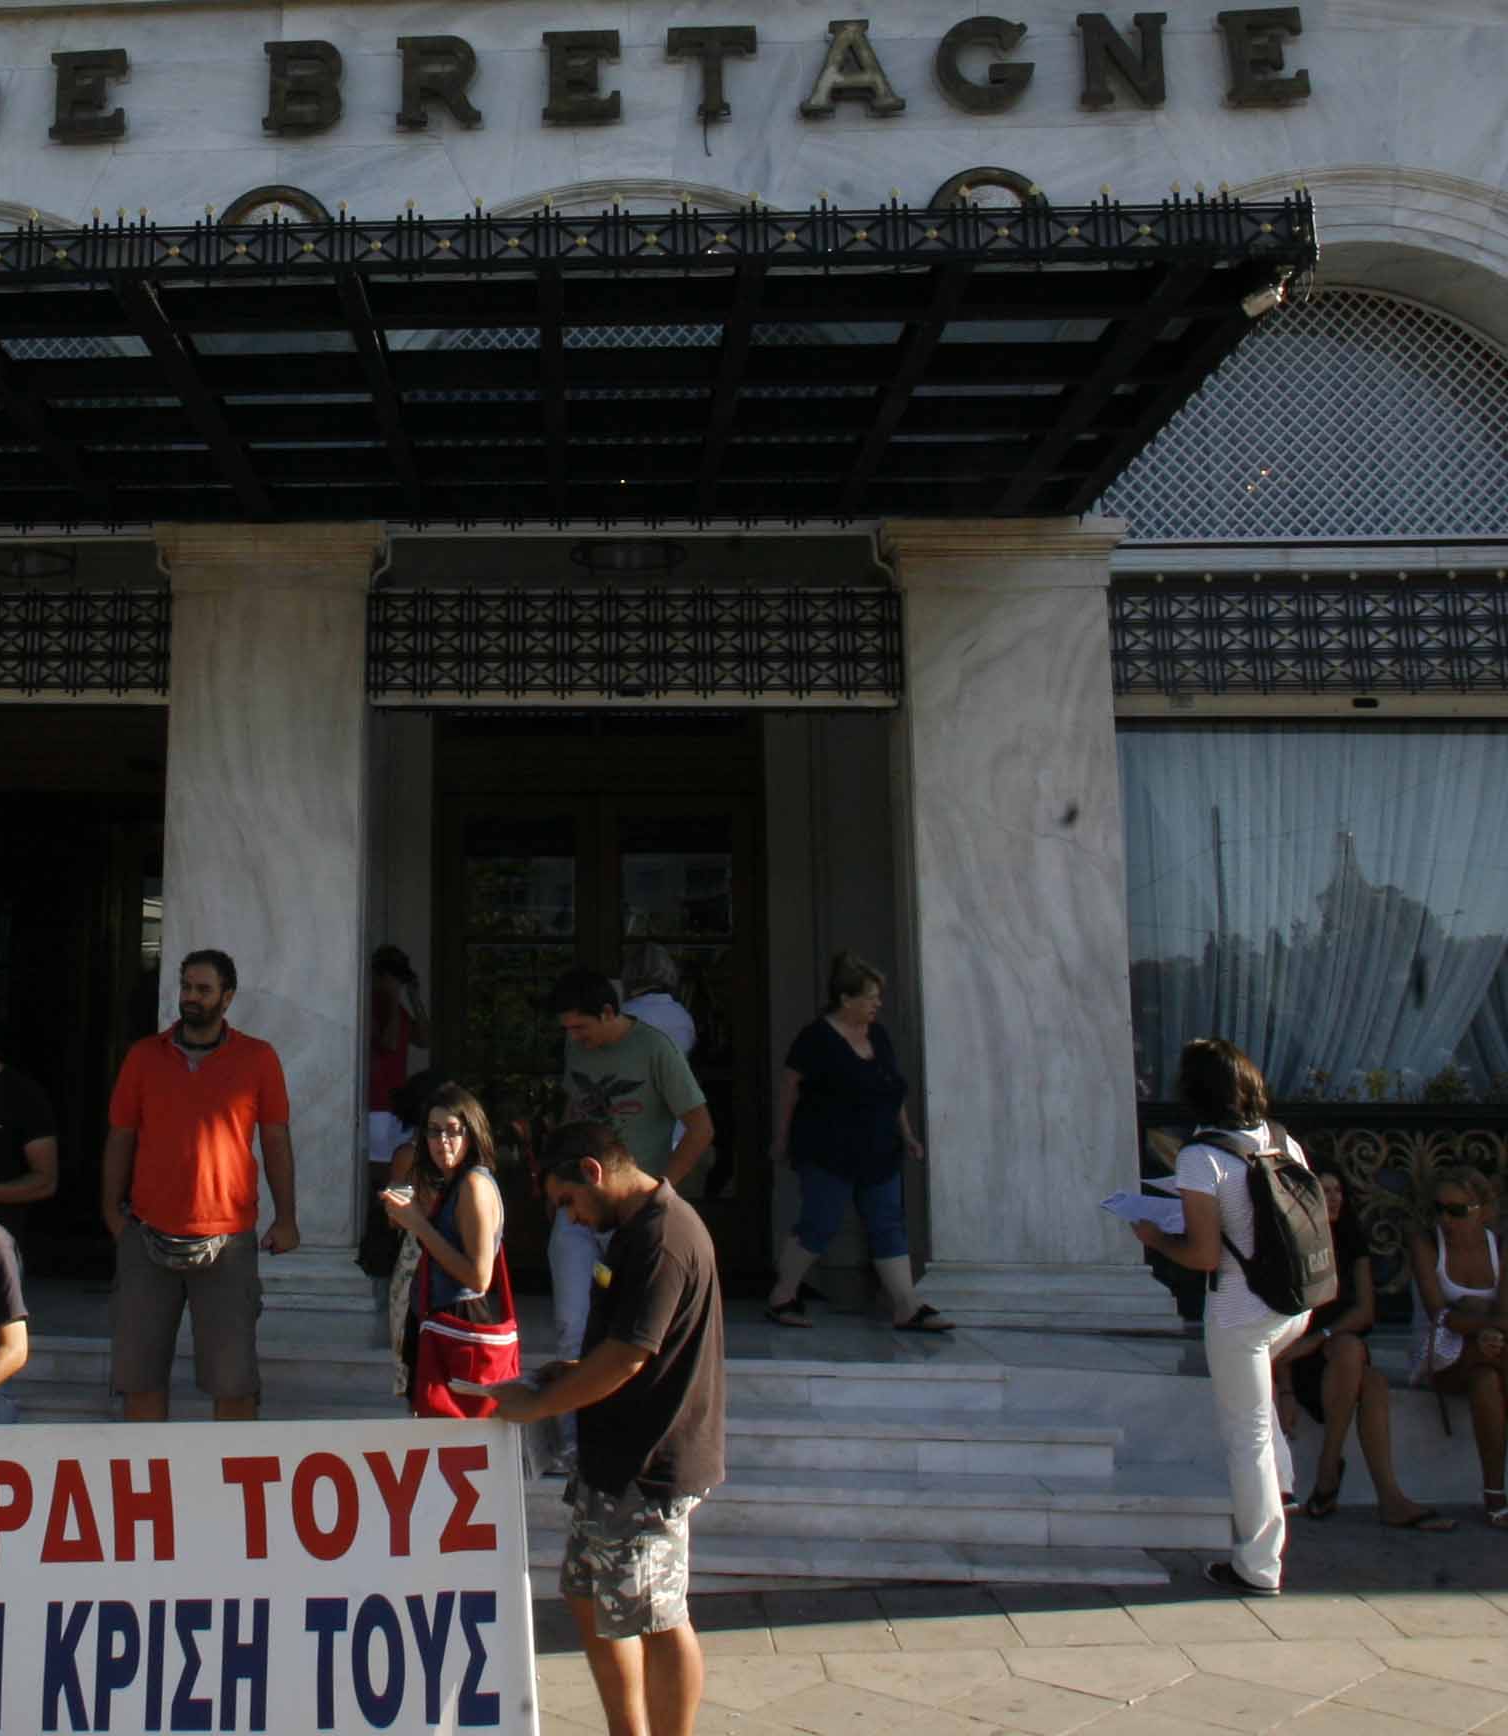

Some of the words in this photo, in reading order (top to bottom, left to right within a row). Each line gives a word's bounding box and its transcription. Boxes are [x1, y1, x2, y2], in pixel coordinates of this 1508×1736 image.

[261, 6, 1314, 141] BRETAGNE
[221, 1446, 498, 1560] ΤΟΥΣ
[41, 1598, 270, 1732] ΚΡΙΣΗ
[304, 1590, 501, 1731] ΤΟΥΣ
